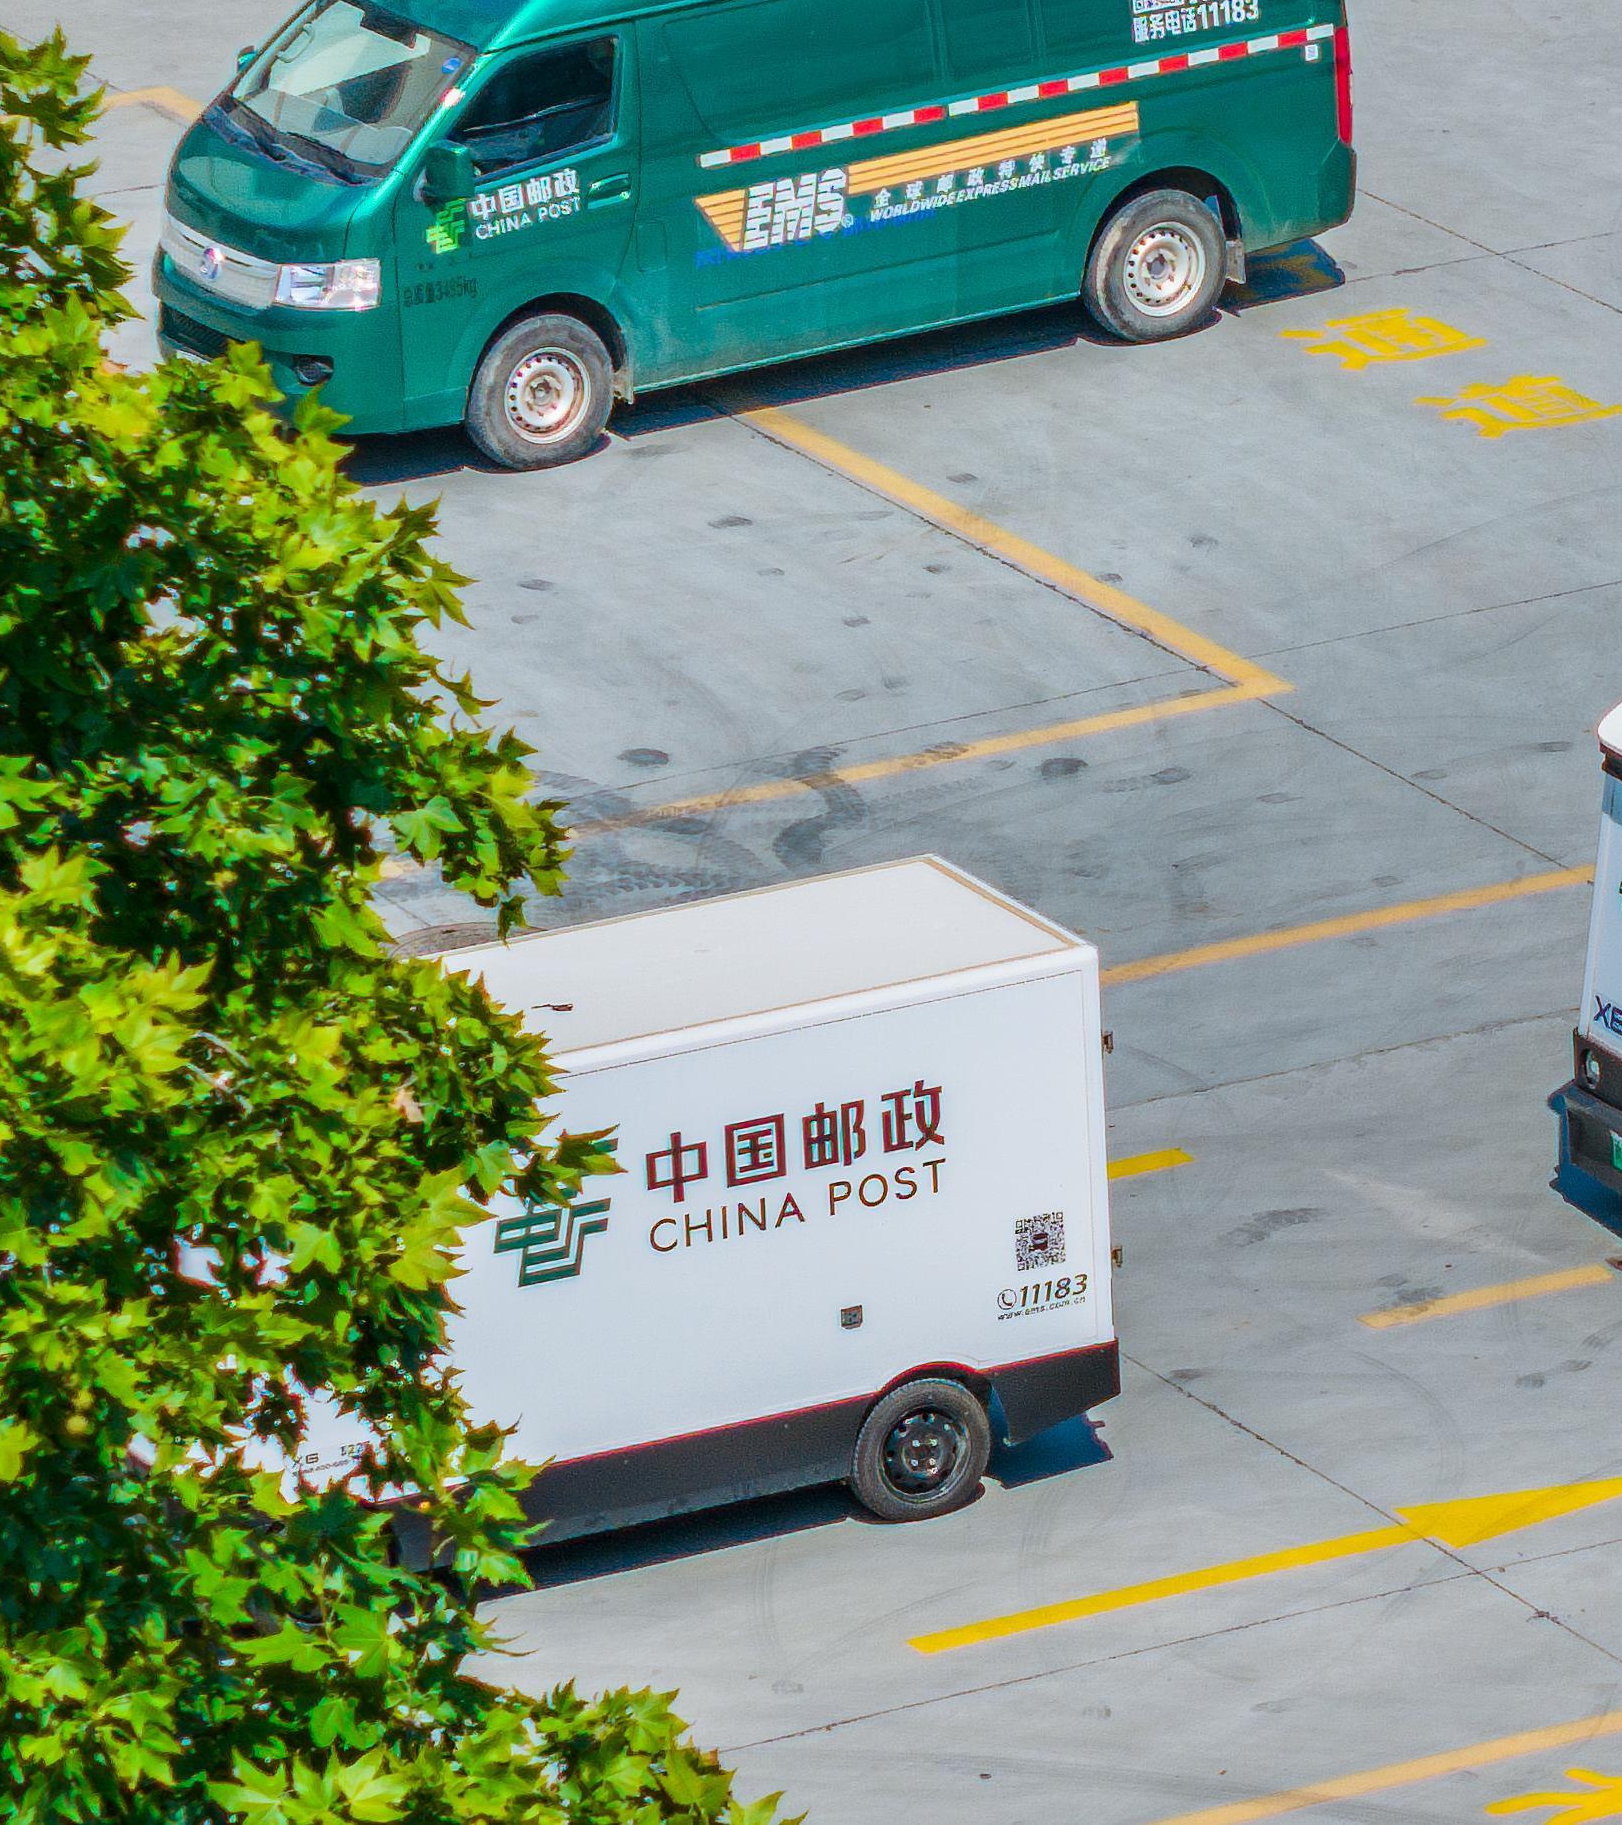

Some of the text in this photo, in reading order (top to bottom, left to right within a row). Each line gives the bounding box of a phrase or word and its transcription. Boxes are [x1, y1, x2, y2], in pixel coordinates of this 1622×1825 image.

[471, 168, 581, 220] 中国邮政
[1051, 155, 1112, 182] SERVICE
[476, 196, 581, 240] CHINA POST
[744, 168, 845, 250] EMS
[645, 1079, 946, 1204] 中国邮政
[649, 1157, 947, 1253] CHINA POST
[1020, 1273, 1088, 1307] 11183
